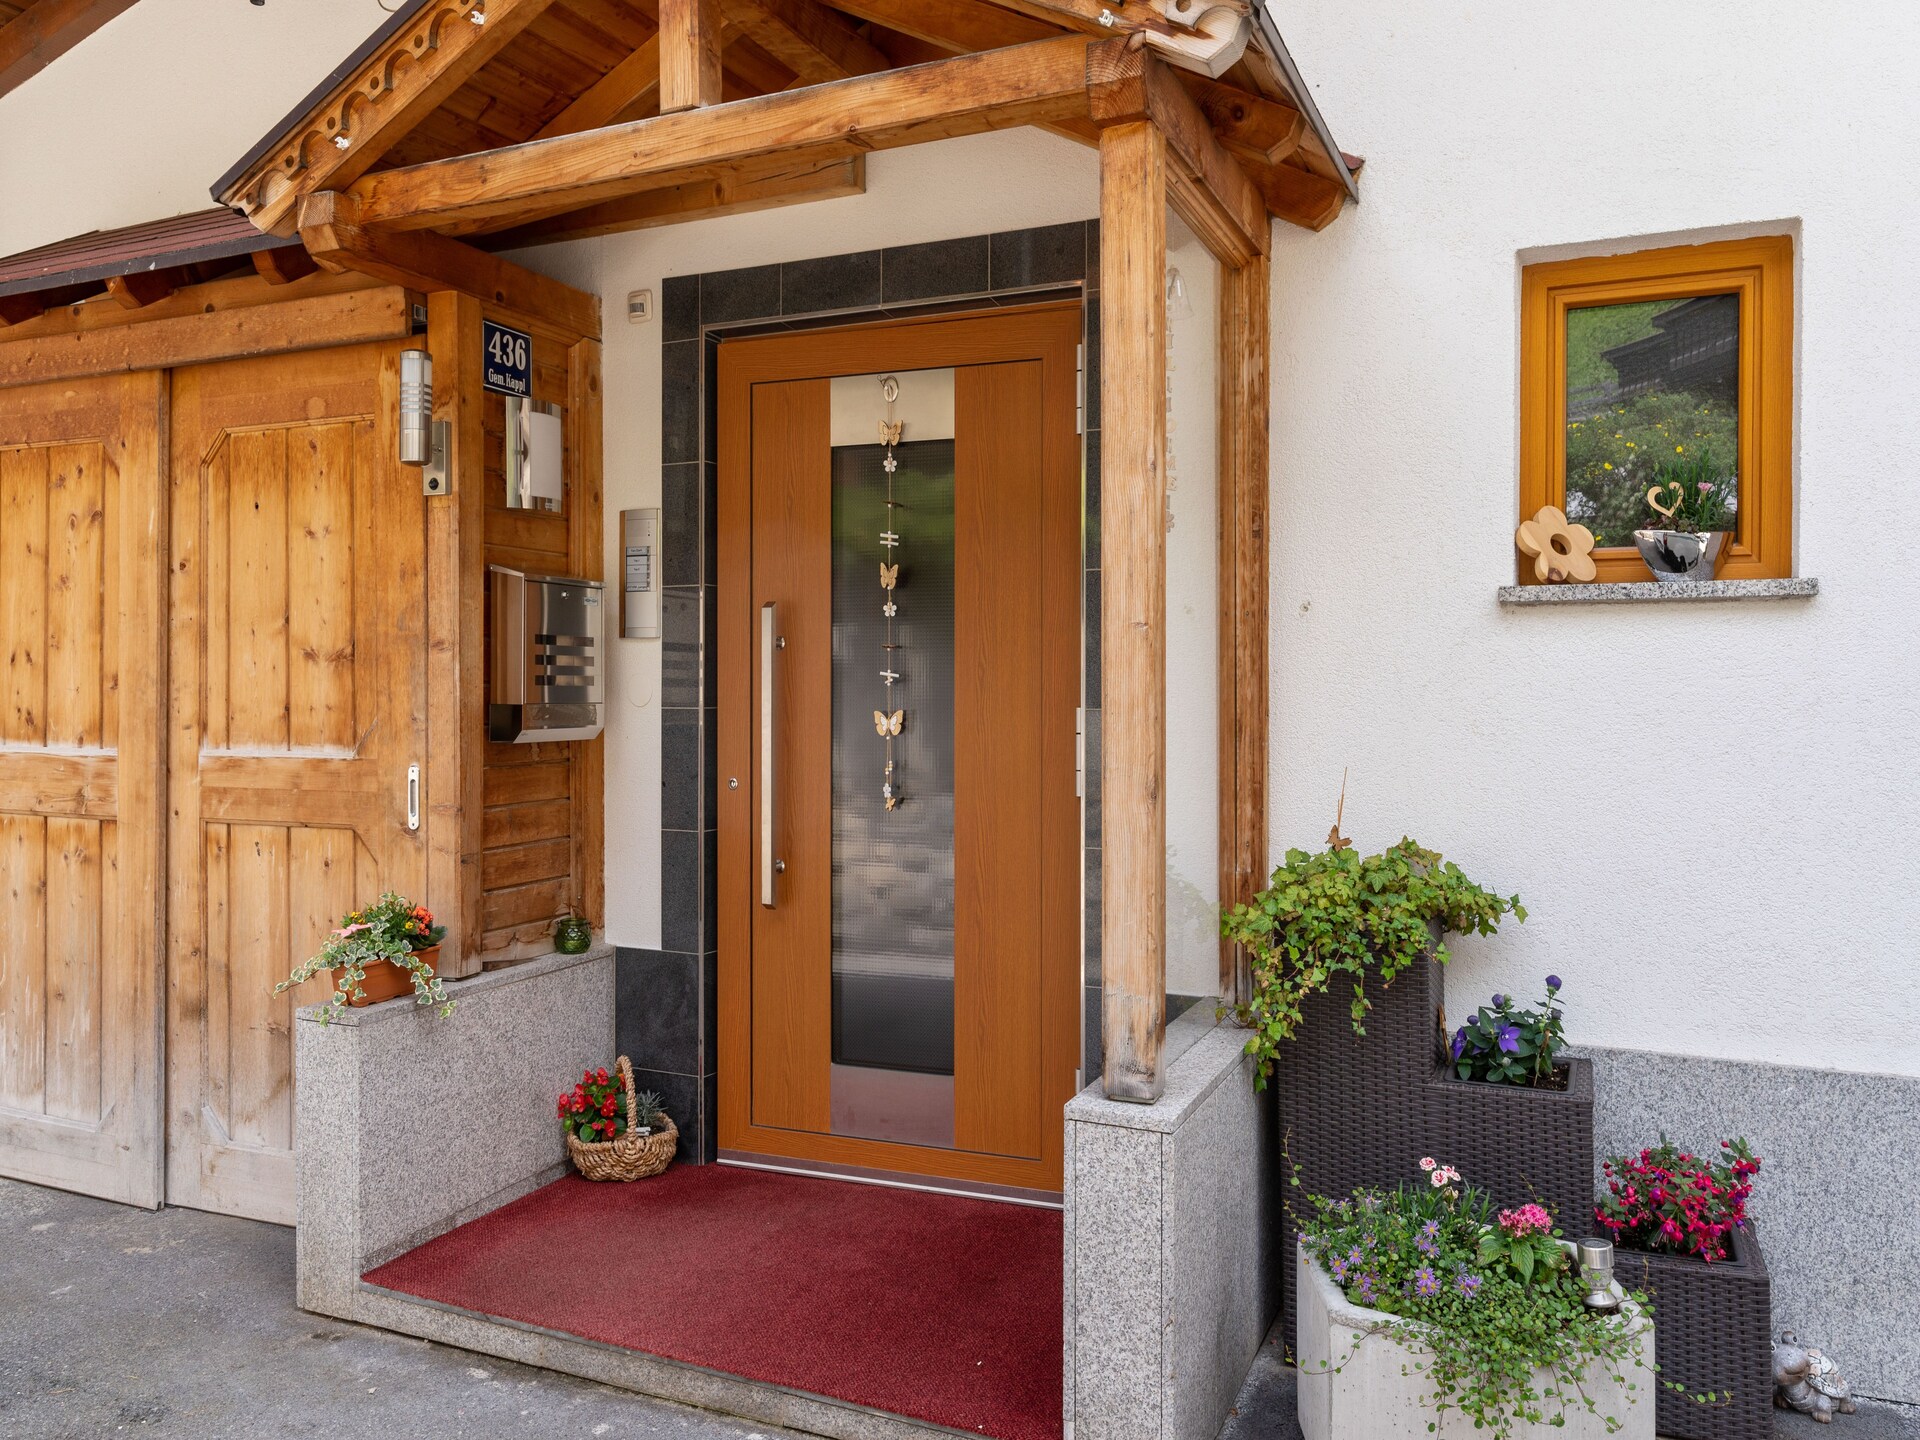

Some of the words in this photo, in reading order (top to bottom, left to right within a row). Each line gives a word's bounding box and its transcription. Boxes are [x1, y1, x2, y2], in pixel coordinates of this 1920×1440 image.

[488, 331, 527, 371] 436
[488, 368, 505, 386] Gem.
[505, 373, 526, 393] Kappl
